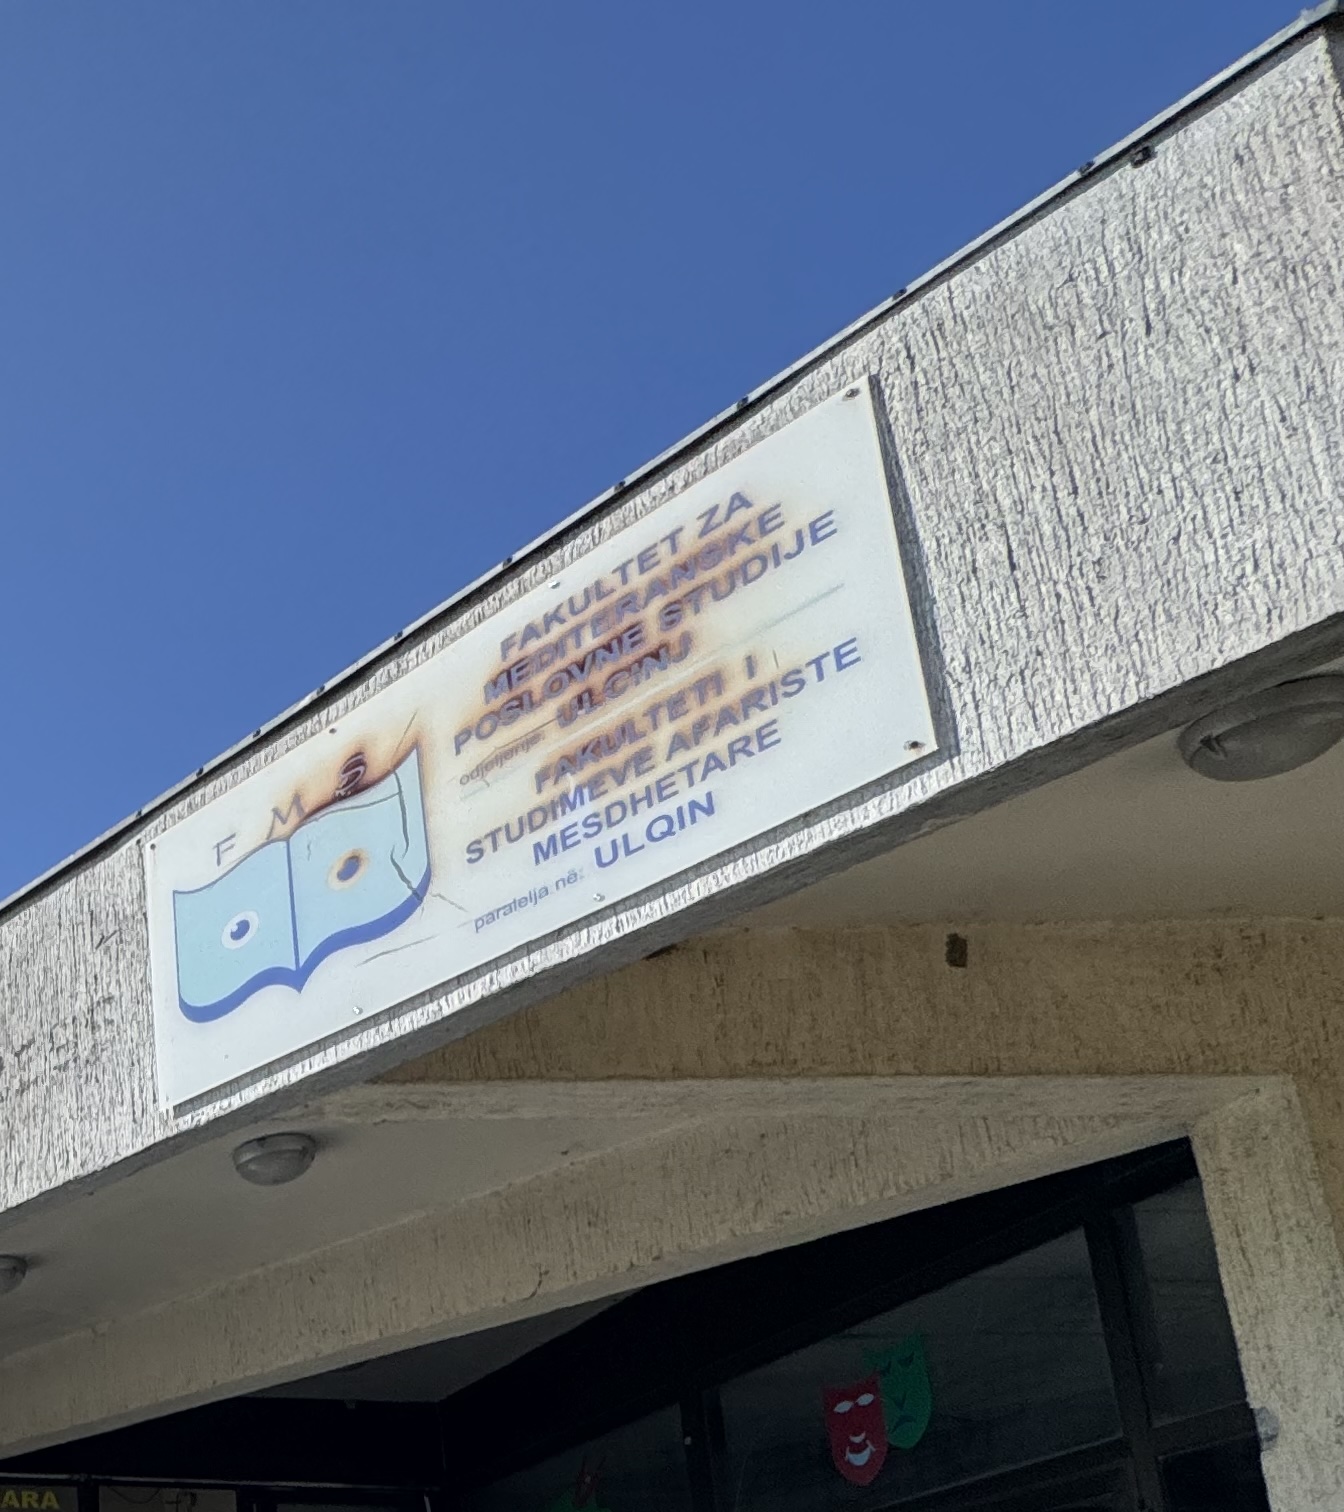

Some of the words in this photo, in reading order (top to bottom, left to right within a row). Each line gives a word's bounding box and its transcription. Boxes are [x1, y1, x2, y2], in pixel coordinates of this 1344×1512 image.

[453, 620, 643, 756] POSLOVNE
[658, 509, 839, 631] STUDIJE
[482, 503, 786, 705] MEDITERANSKE
[500, 526, 686, 662] FAKULTET
[697, 491, 755, 538] ZA
[466, 747, 656, 864] STUDIMEVE
[666, 637, 863, 762] AFARISTE
[534, 670, 725, 794] FAKULTETI
[743, 654, 758, 681] I
[555, 630, 694, 728] ULCINJ
[533, 719, 783, 866] MESDHETARE
[594, 791, 717, 869] ULQIN
